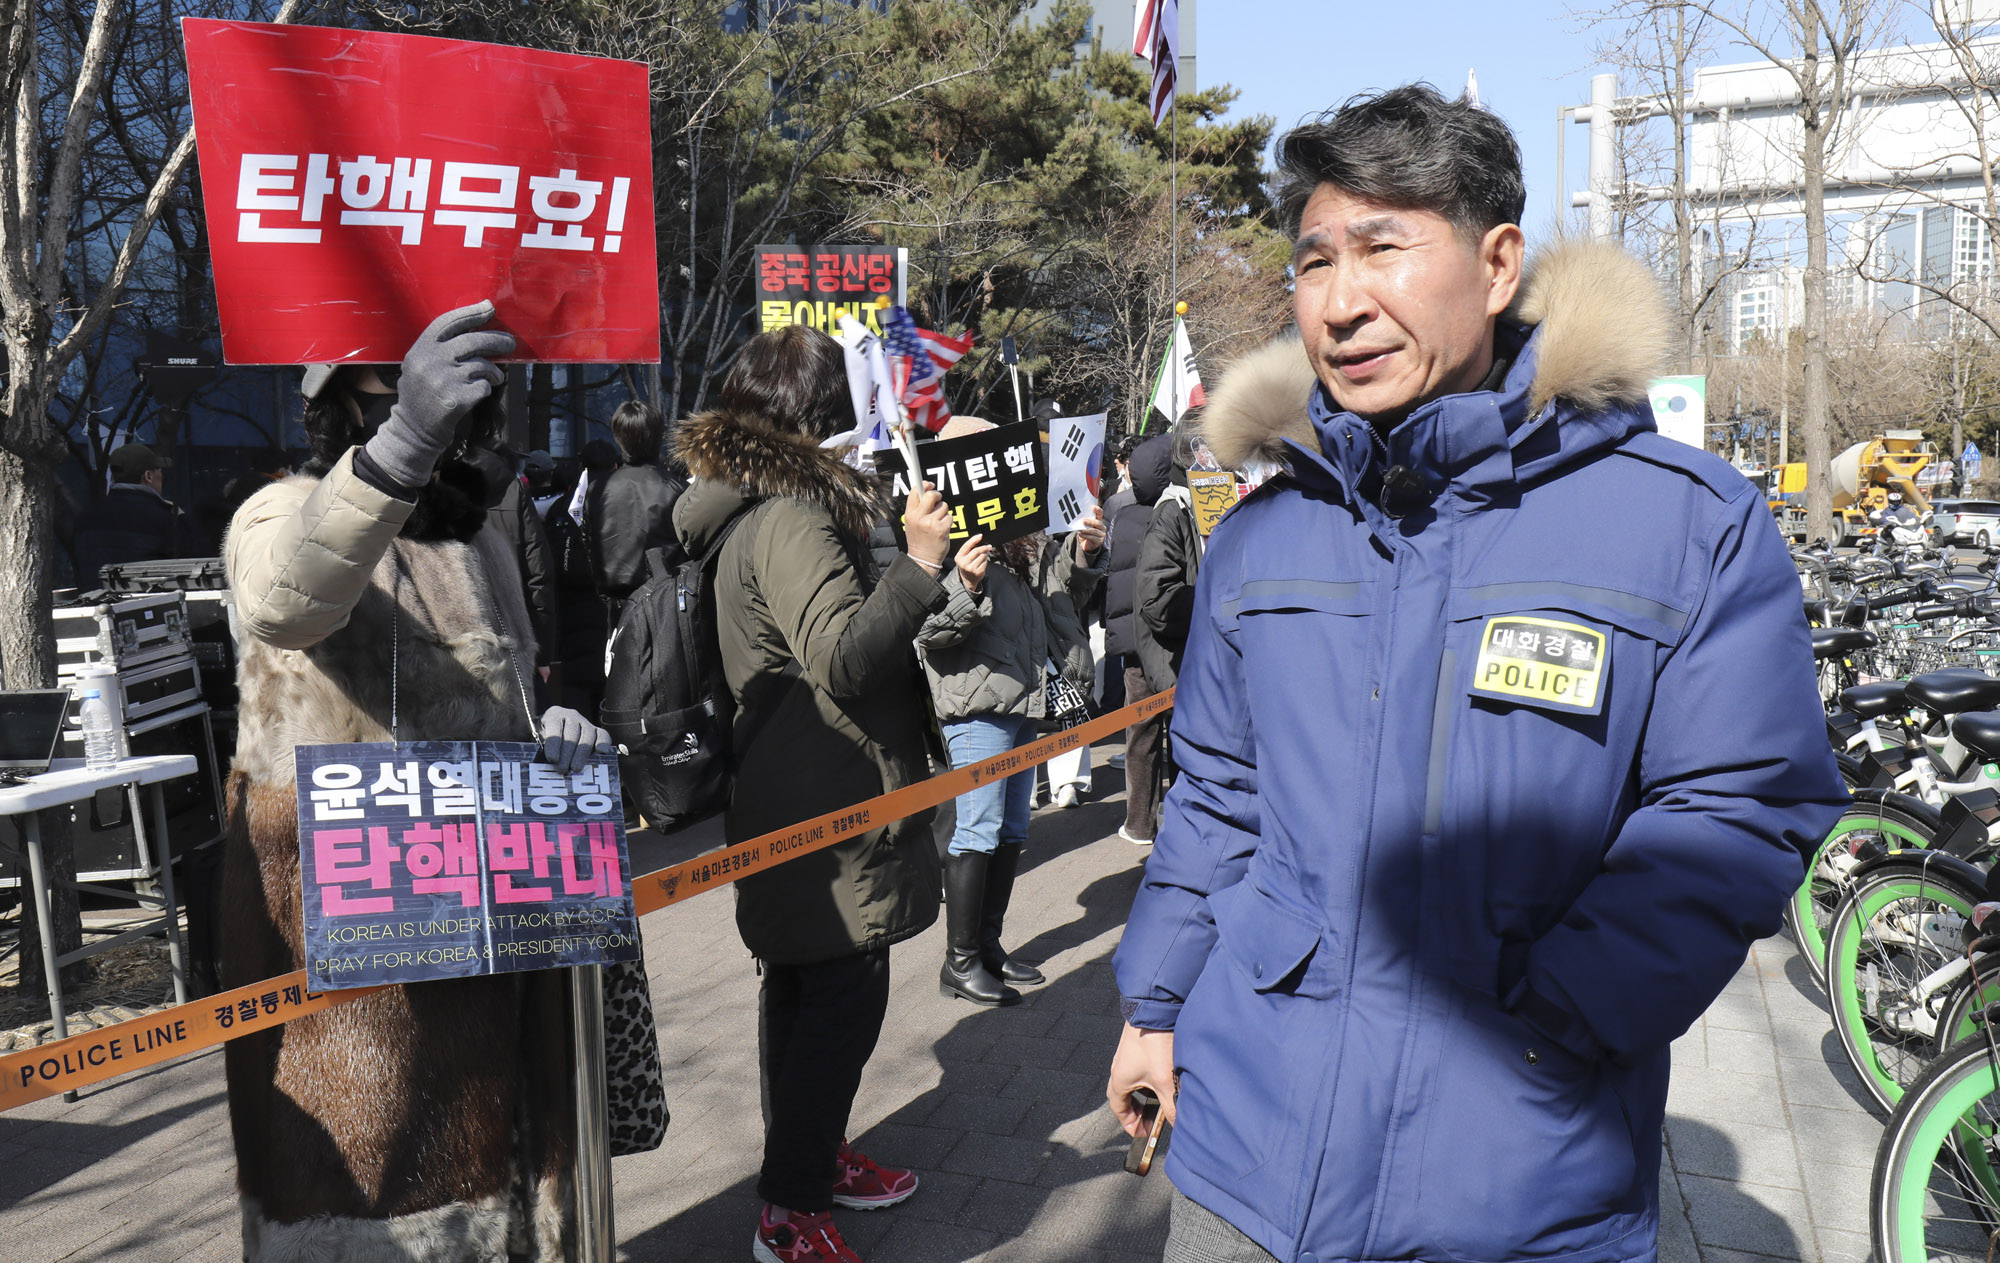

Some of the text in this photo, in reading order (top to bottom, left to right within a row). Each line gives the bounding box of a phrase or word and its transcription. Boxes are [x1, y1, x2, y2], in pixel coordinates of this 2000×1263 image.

[236, 153, 631, 253] 탄핵무효!
[761, 253, 894, 293] 중국 공산당
[167, 357, 199, 365] SHURE
[1491, 628, 1595, 661] 대화경찰
[1484, 662, 1588, 698] POLICE
[1025, 746, 1044, 761] POLICE
[1044, 743, 1055, 755] LINE
[310, 760, 613, 821] 윤석열대통령
[691, 809, 870, 885] 서울마포경찰서 POLICE LINE 경찰통제선
[313, 821, 623, 918] 탄핵반대
[327, 908, 620, 944] KOREA IS UNDER ATTACK BY C.C.P.
[315, 933, 632, 975] PRAY FOR KOREA & PRESIDENT YOON
[20, 1038, 123, 1088] POLICE
[133, 1020, 187, 1054] LINE
